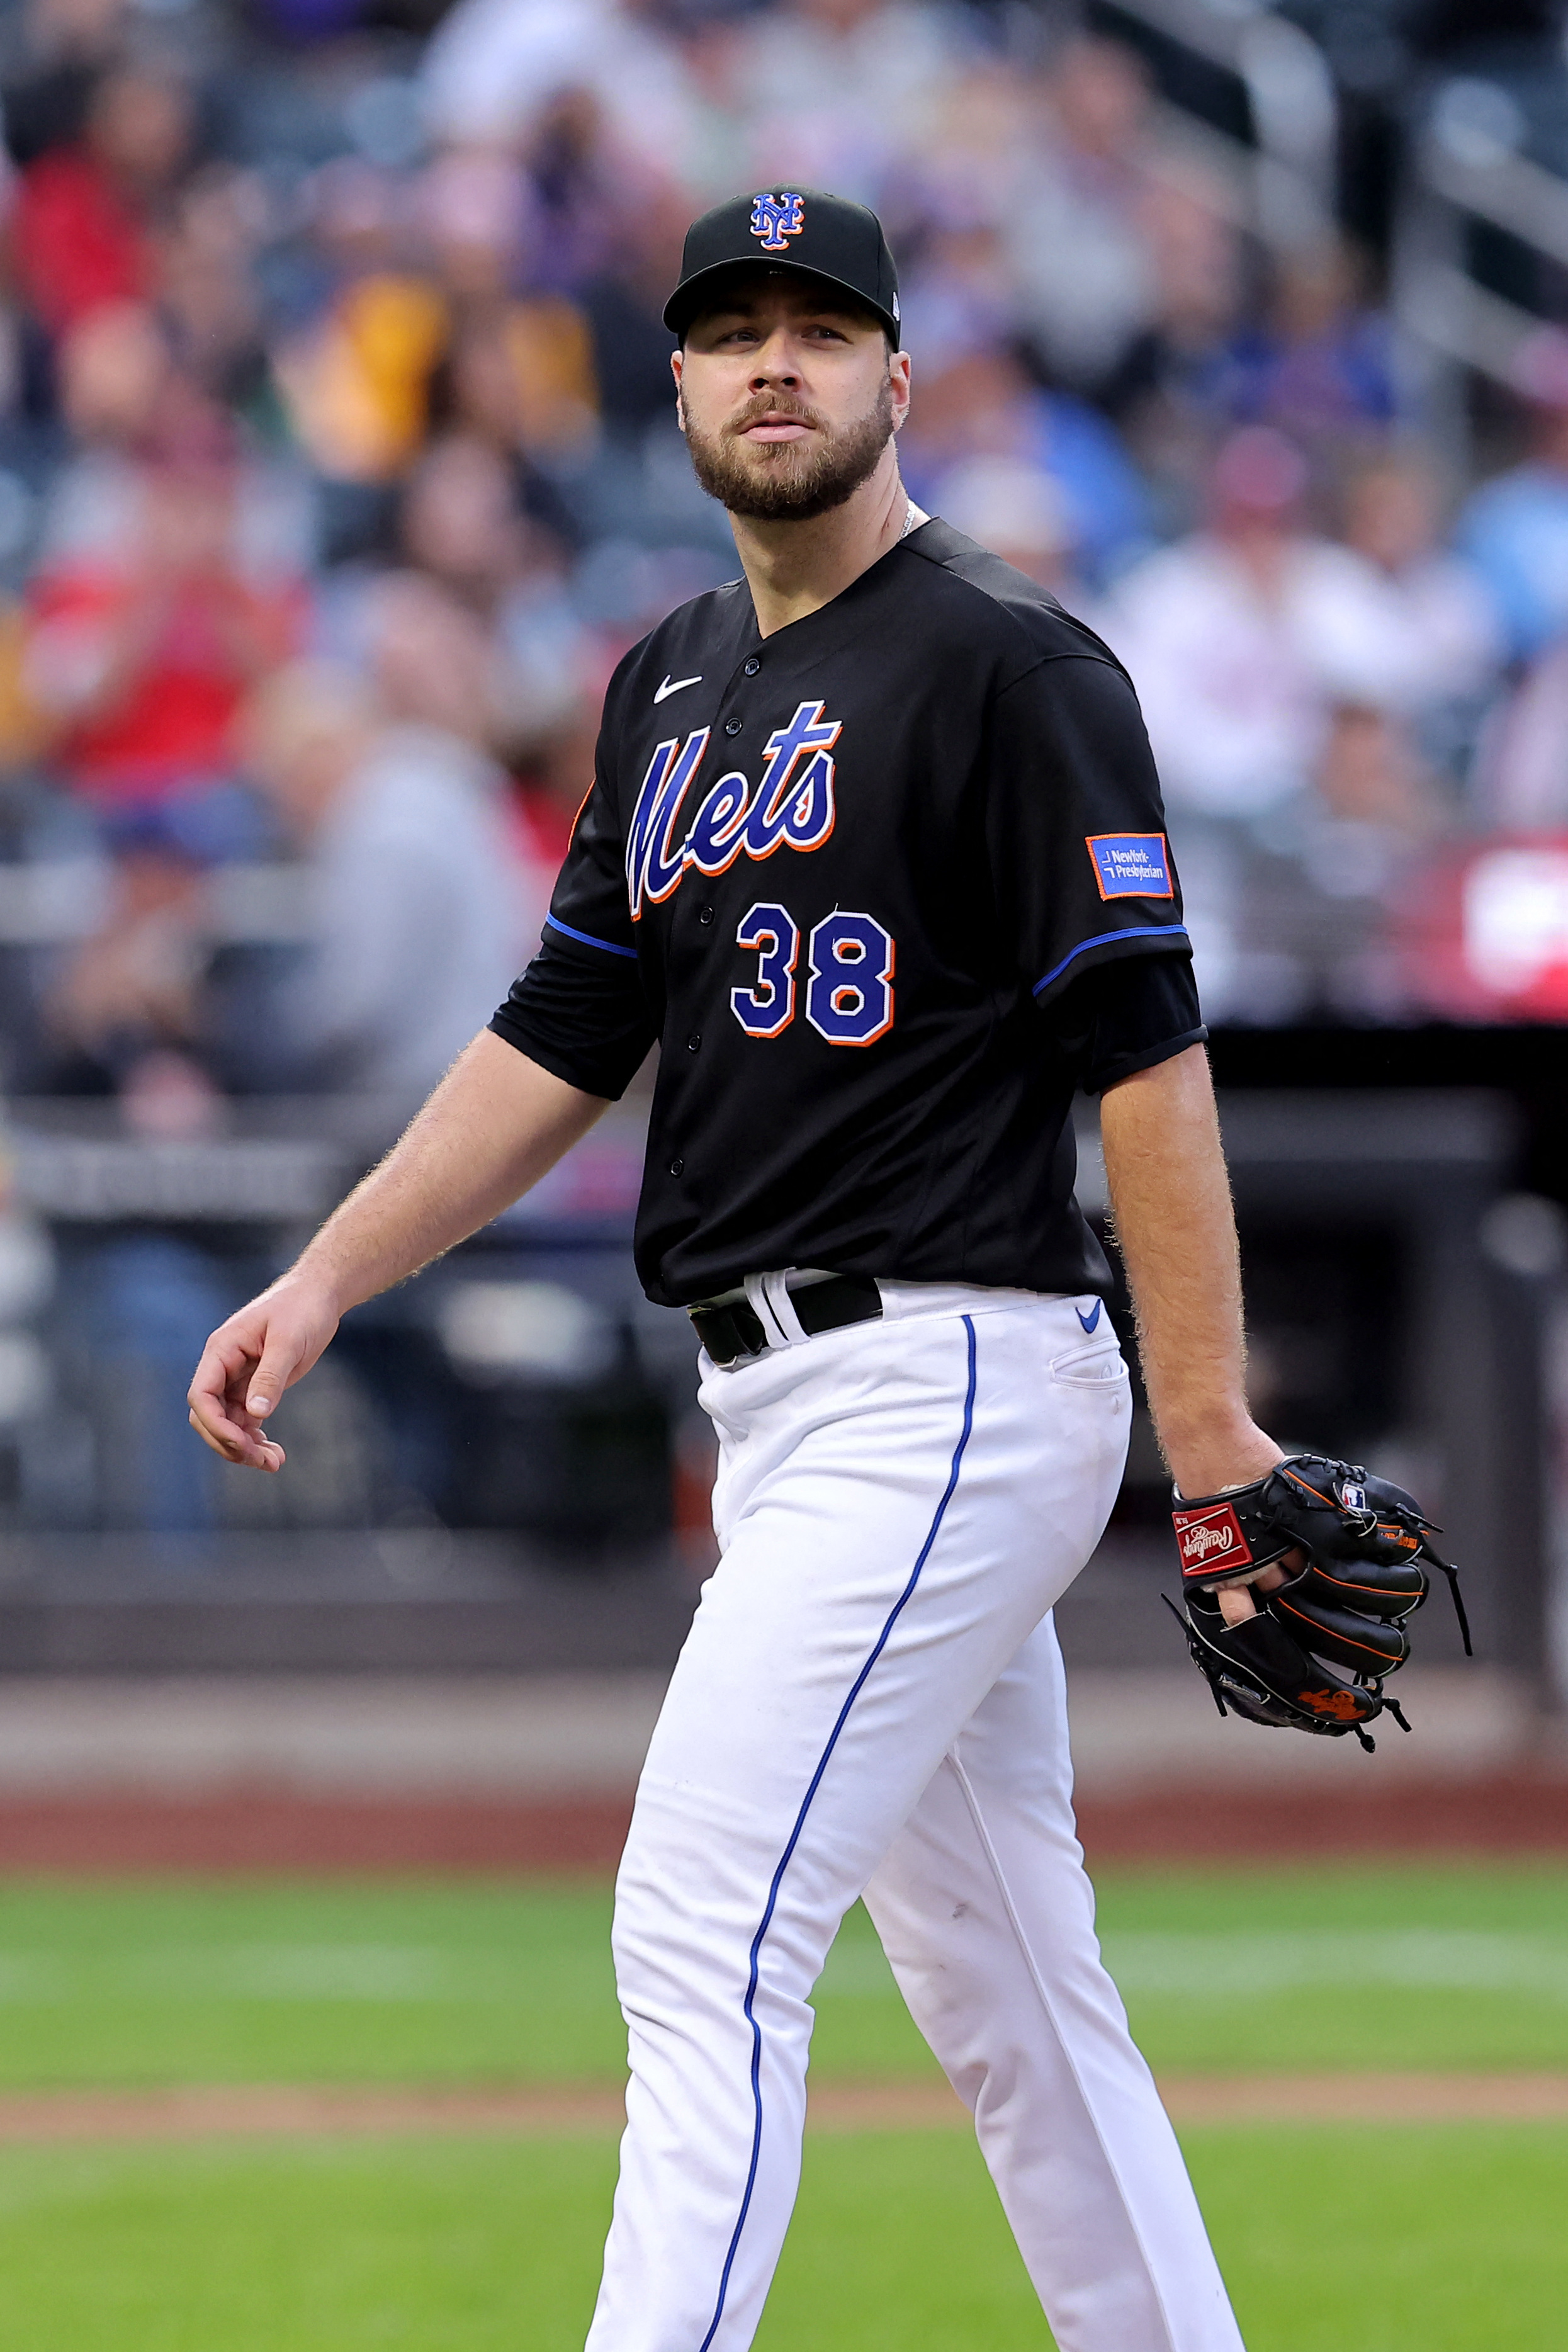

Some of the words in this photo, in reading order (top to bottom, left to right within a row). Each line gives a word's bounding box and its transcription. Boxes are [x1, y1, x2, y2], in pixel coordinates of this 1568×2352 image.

[625, 699, 843, 922] Mets
[1115, 864, 1163, 881] Presbyterian
[730, 902, 895, 1047] 38
[1183, 1525, 1233, 1559] Rawlings
